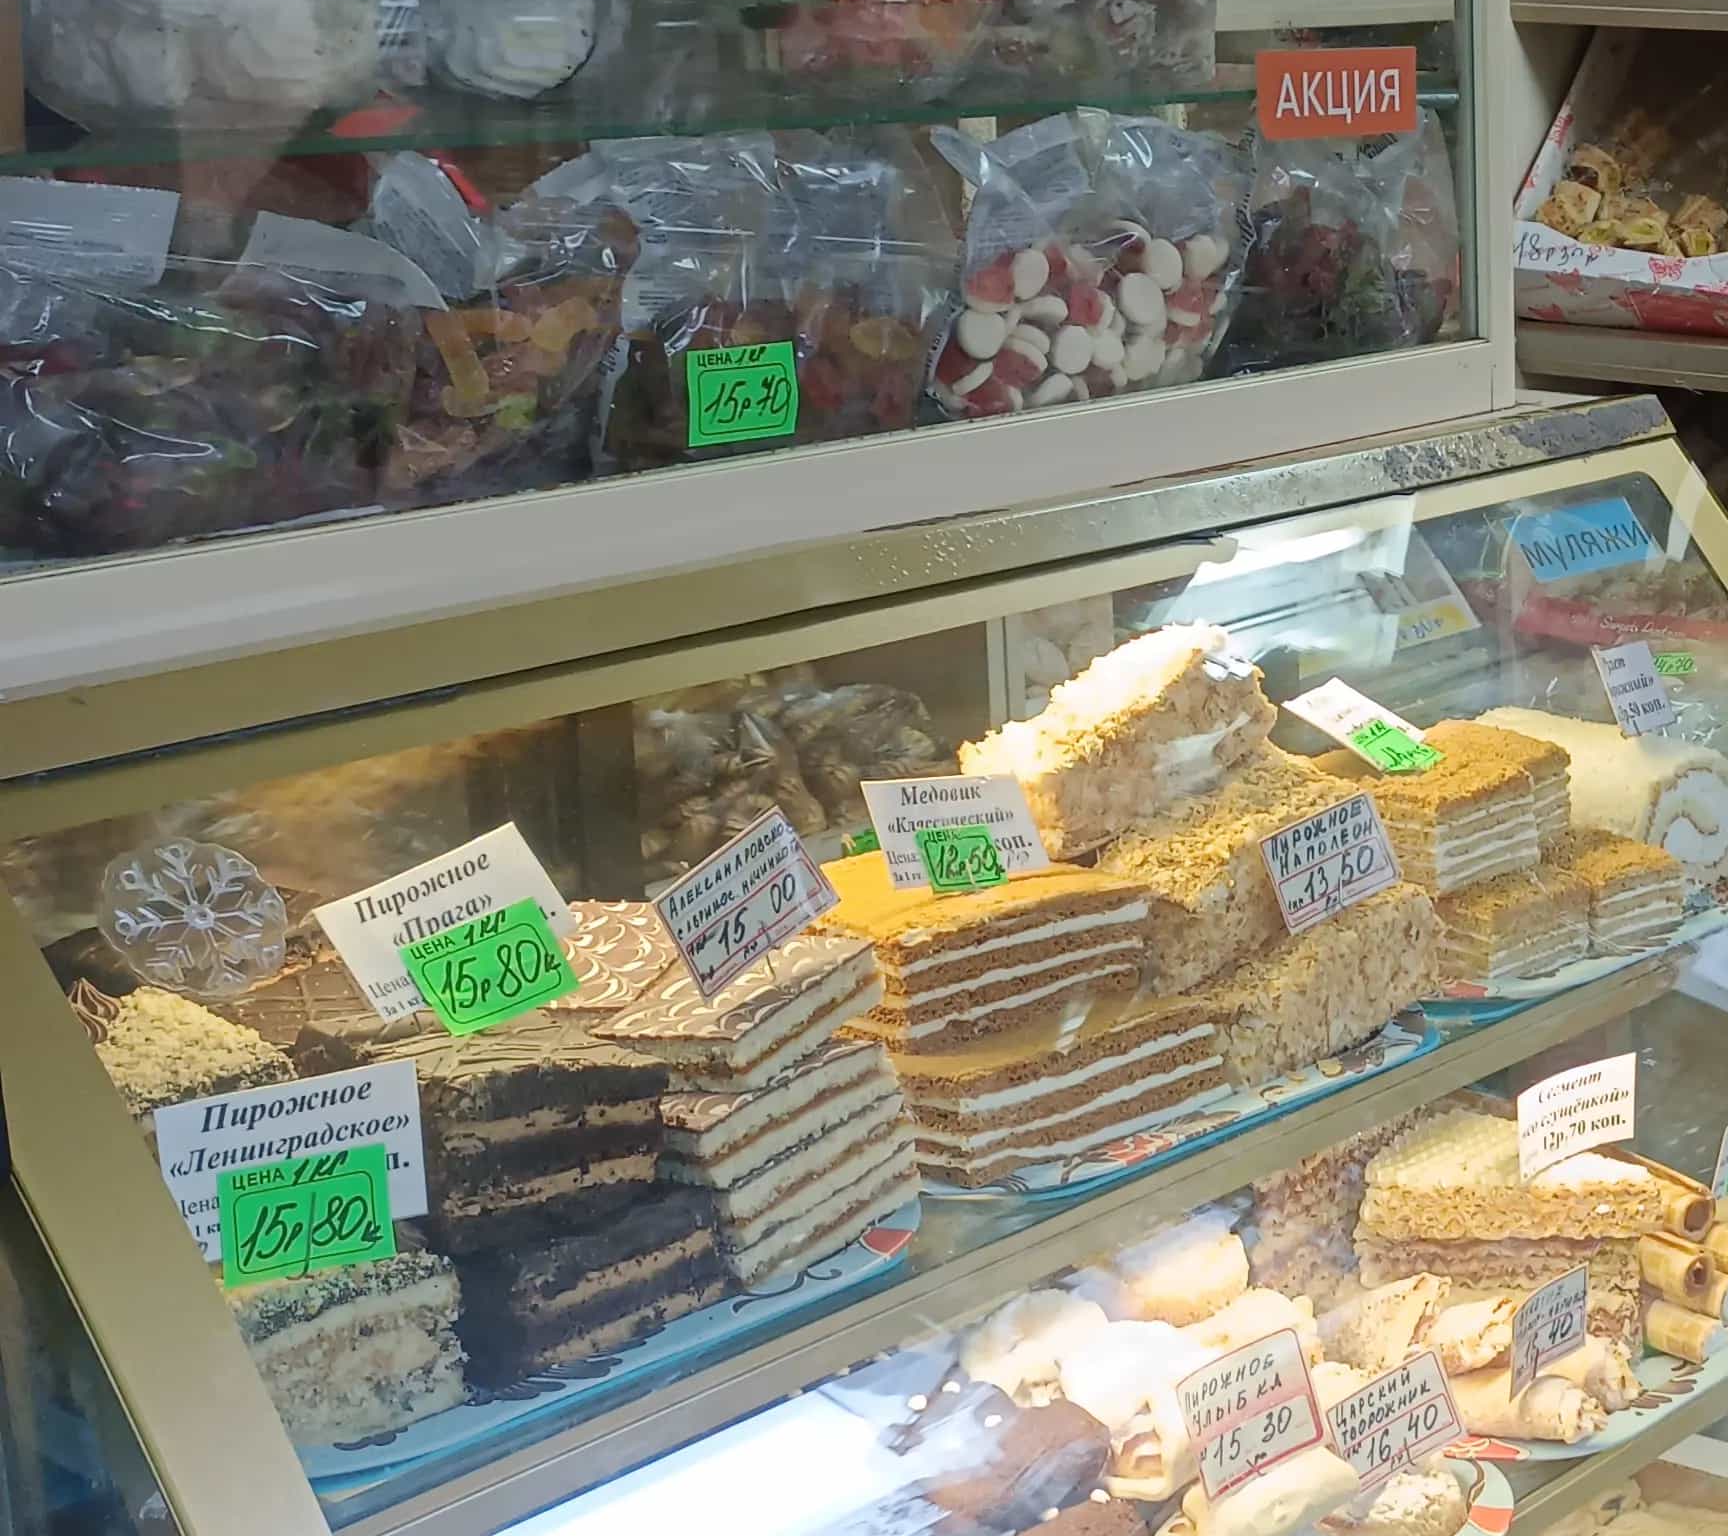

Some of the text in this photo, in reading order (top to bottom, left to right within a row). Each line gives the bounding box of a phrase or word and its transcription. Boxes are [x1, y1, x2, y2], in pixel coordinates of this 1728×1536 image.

[1275, 68, 1401, 121] АКЦИЯ
[697, 352, 733, 368] ЦЕНА
[1521, 521, 1649, 571] МУЛЯЖИ
[901, 786, 982, 806] Медовик
[1271, 800, 1365, 861] ПИРОЖНОЕ
[1280, 818, 1374, 877] НАПОЛЕОН
[354, 851, 490, 923] Пирожное
[393, 892, 493, 948] «Прага»
[409, 935, 456, 961] ЦЕНА
[201, 1080, 373, 1134] Пирожное
[1590, 1114, 1626, 1133] коп.
[170, 1114, 410, 1179] «Ленинградское»
[232, 1167, 285, 1191] ЦЕНА
[1184, 1353, 1275, 1408] ПИРОЖНОЕ
[1336, 1367, 1412, 1428] ЦАРСКИЙ
[1342, 1382, 1432, 1444] ТВОРОЖНИК
